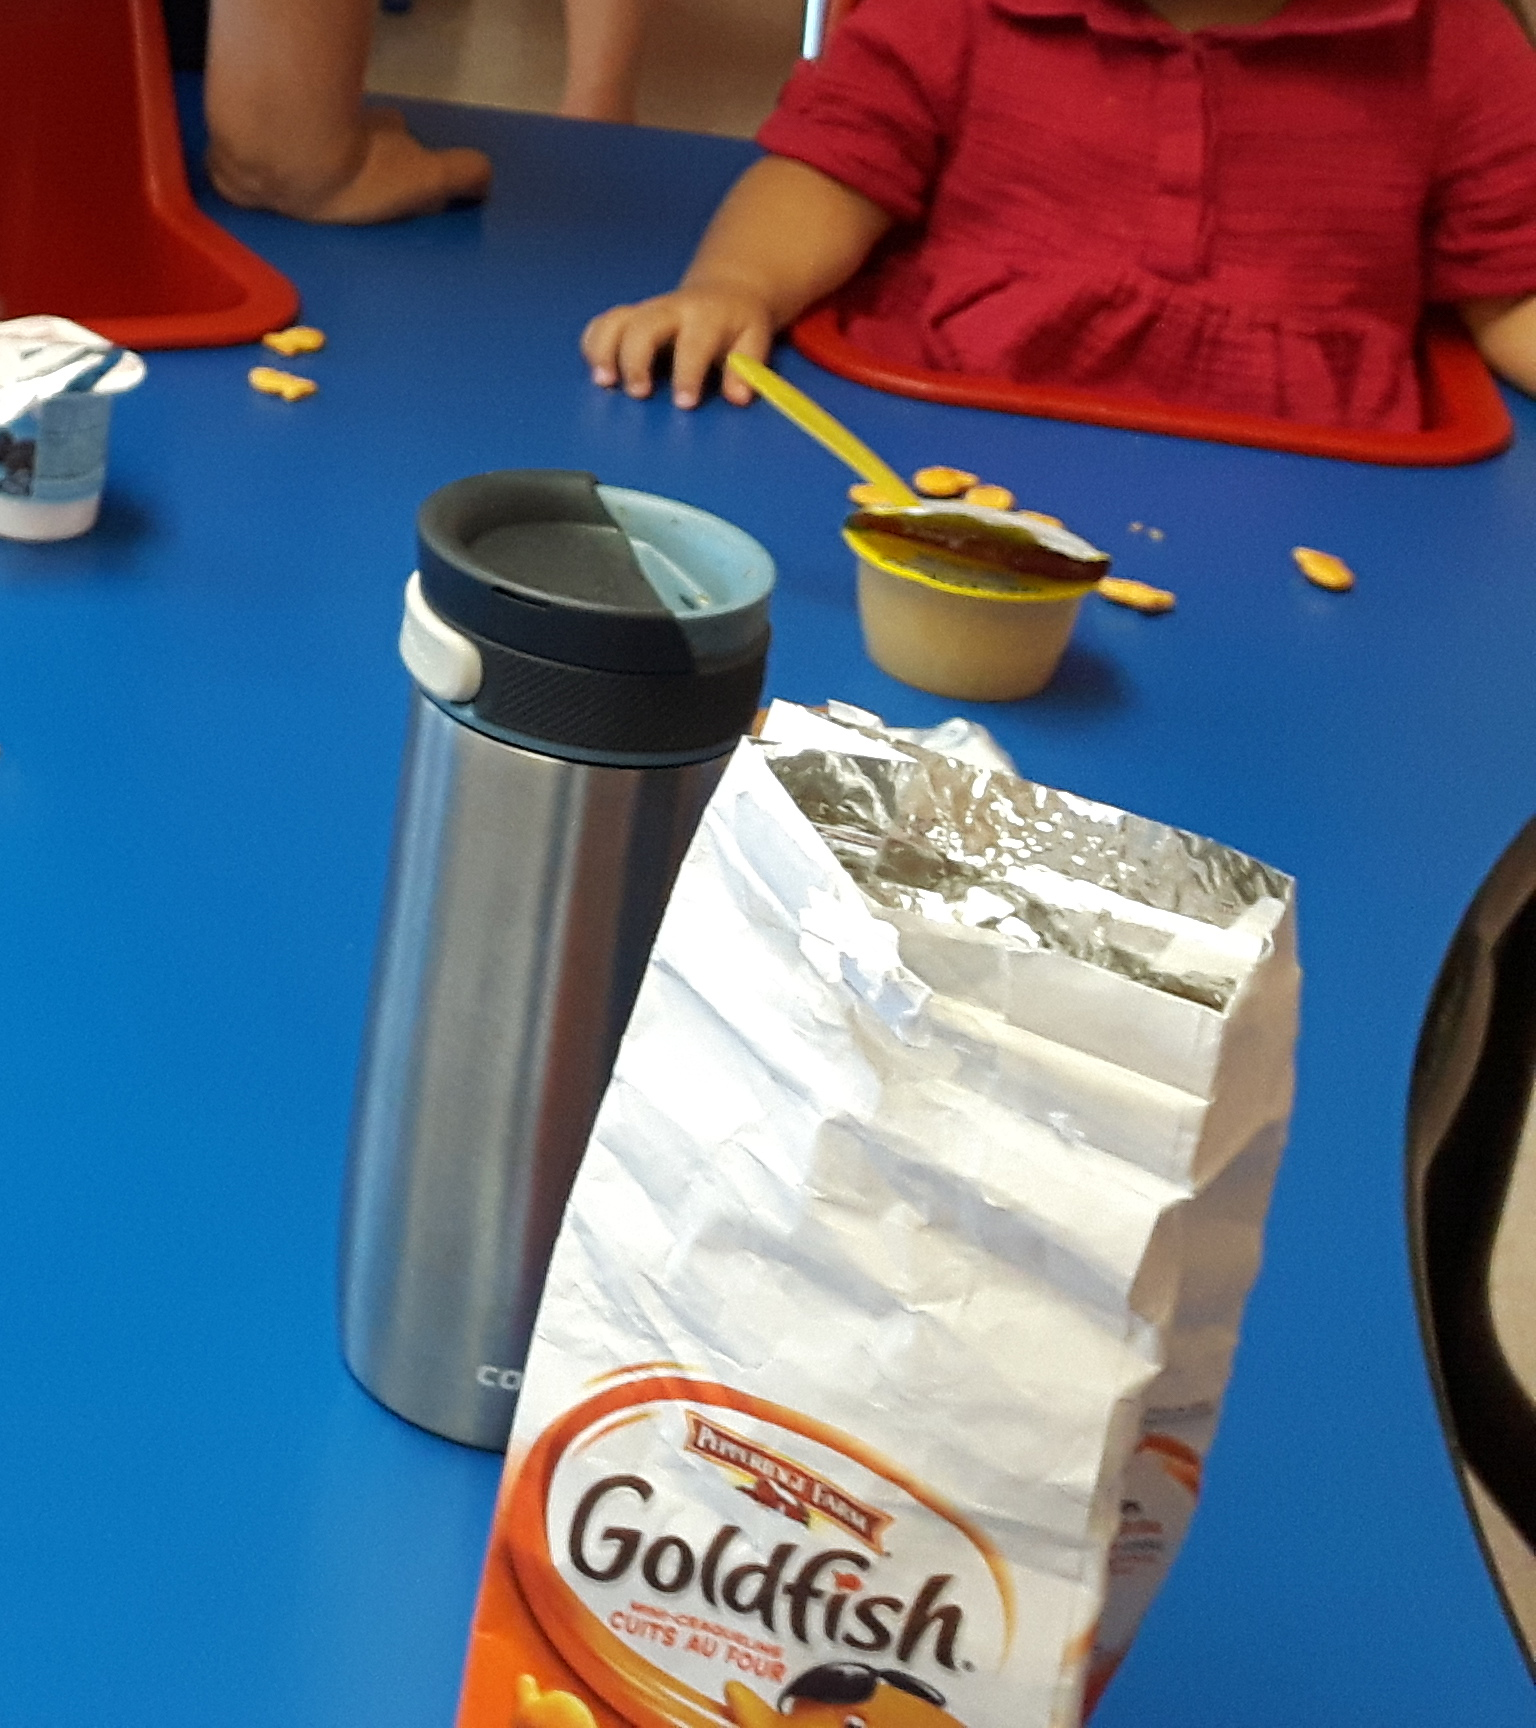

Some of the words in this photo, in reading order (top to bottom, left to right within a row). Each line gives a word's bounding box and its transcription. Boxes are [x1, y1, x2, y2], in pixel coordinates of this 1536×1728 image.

[568, 1474, 968, 1671] Goldfish
[609, 1610, 678, 1647] CUITS
[685, 1634, 719, 1659] AU
[725, 1644, 787, 1684] FOUR
